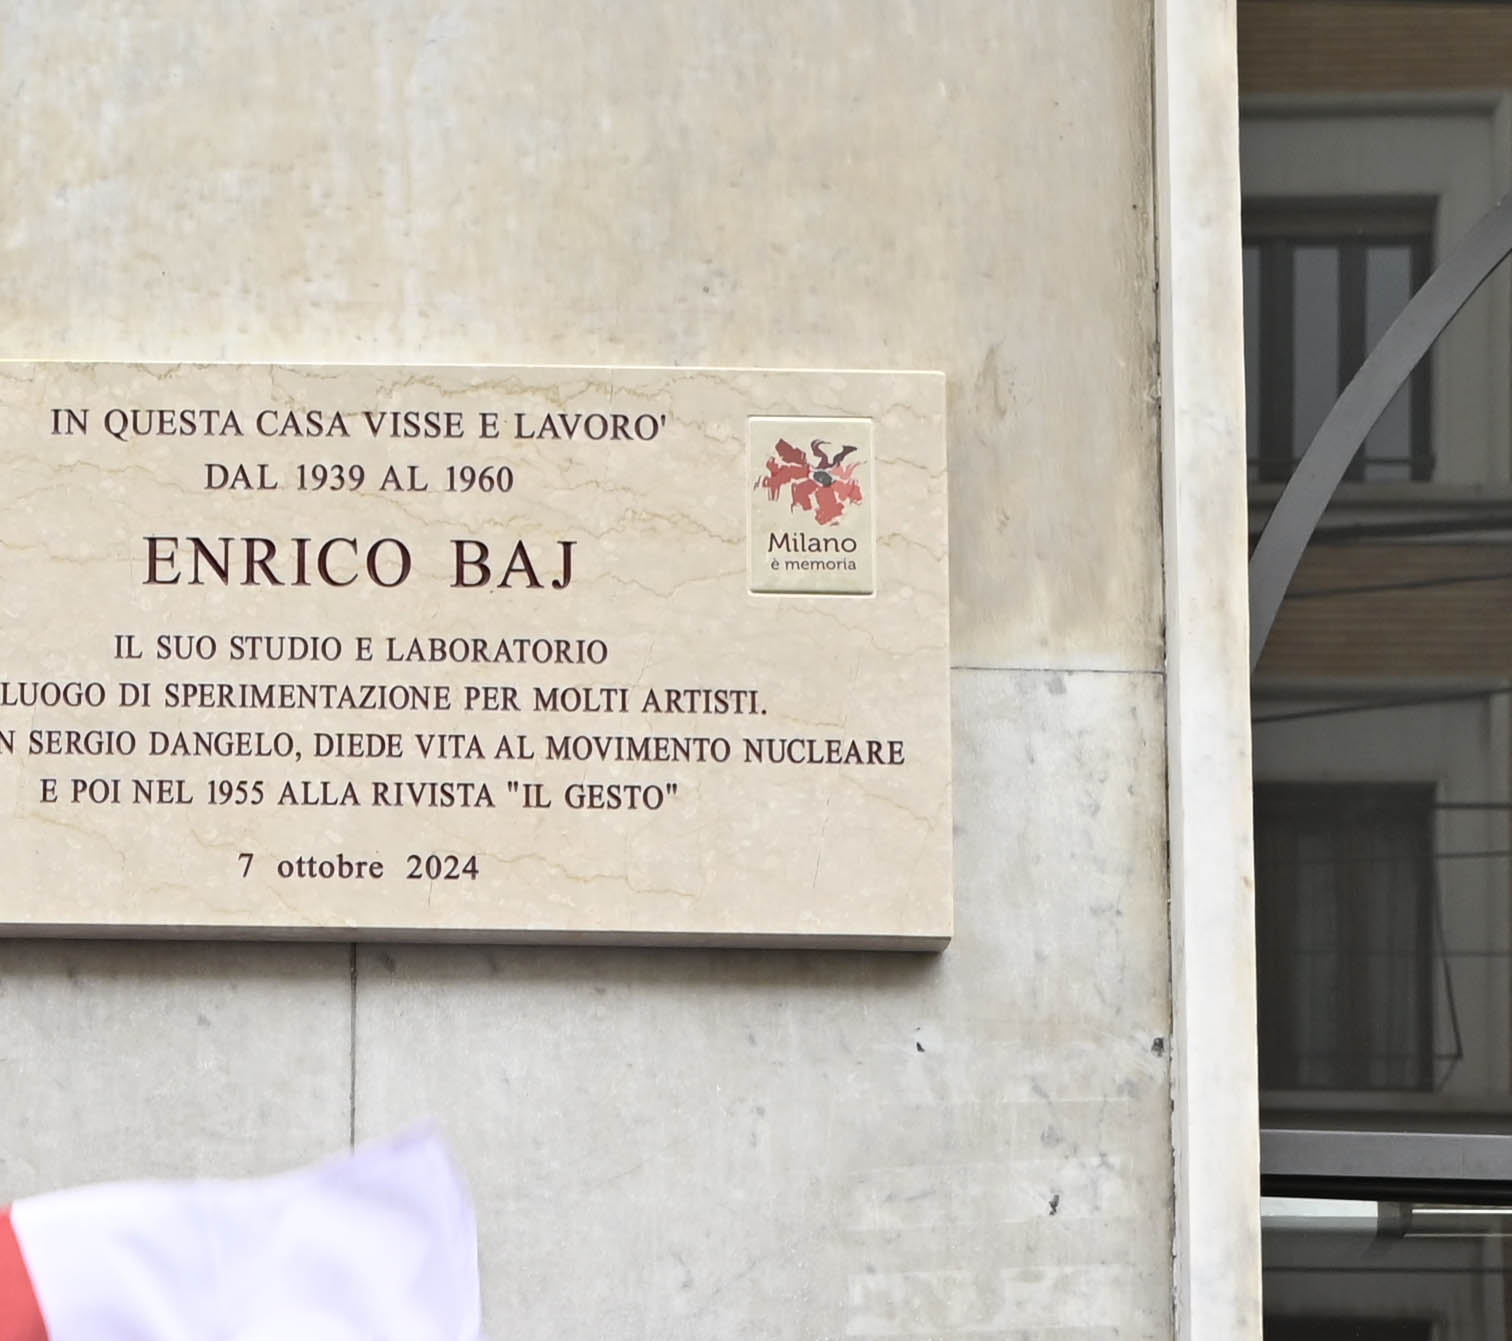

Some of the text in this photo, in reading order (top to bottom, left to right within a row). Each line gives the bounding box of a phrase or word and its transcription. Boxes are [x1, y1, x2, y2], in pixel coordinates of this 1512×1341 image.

[50, 408, 90, 436] IN
[103, 408, 245, 443] QUESTA
[256, 409, 352, 438] CASA
[360, 410, 465, 439] VISSE
[478, 412, 500, 439] E
[204, 463, 514, 493] DAL 1939 AL 1960
[768, 532, 857, 553] Milano
[142, 536, 578, 591] ENRICO BAJ
[771, 558, 856, 571] è memoria
[114, 634, 608, 665] IL SUO STUDIO E LABORATORIO
[0, 681, 106, 708] LUOGO
[118, 682, 151, 708] DI
[164, 682, 452, 711] SPERIMENTAZIONE
[463, 685, 522, 712] PER
[532, 686, 629, 714] MOLTI
[640, 687, 768, 716] ARTISTI.
[28, 729, 137, 756] SERGIO
[148, 730, 302, 763] DANGELO,
[313, 732, 404, 759] DIEDE
[414, 733, 486, 760] VITA
[493, 734, 535, 760] AL
[545, 735, 731, 764] MOVIMENTO
[742, 737, 906, 766] NUCLEARE
[39, 778, 678, 811] E POI NEL 1955 ALLA RIVISTA "IL GESTO"
[238, 852, 480, 881] 7 ottobre 2024
